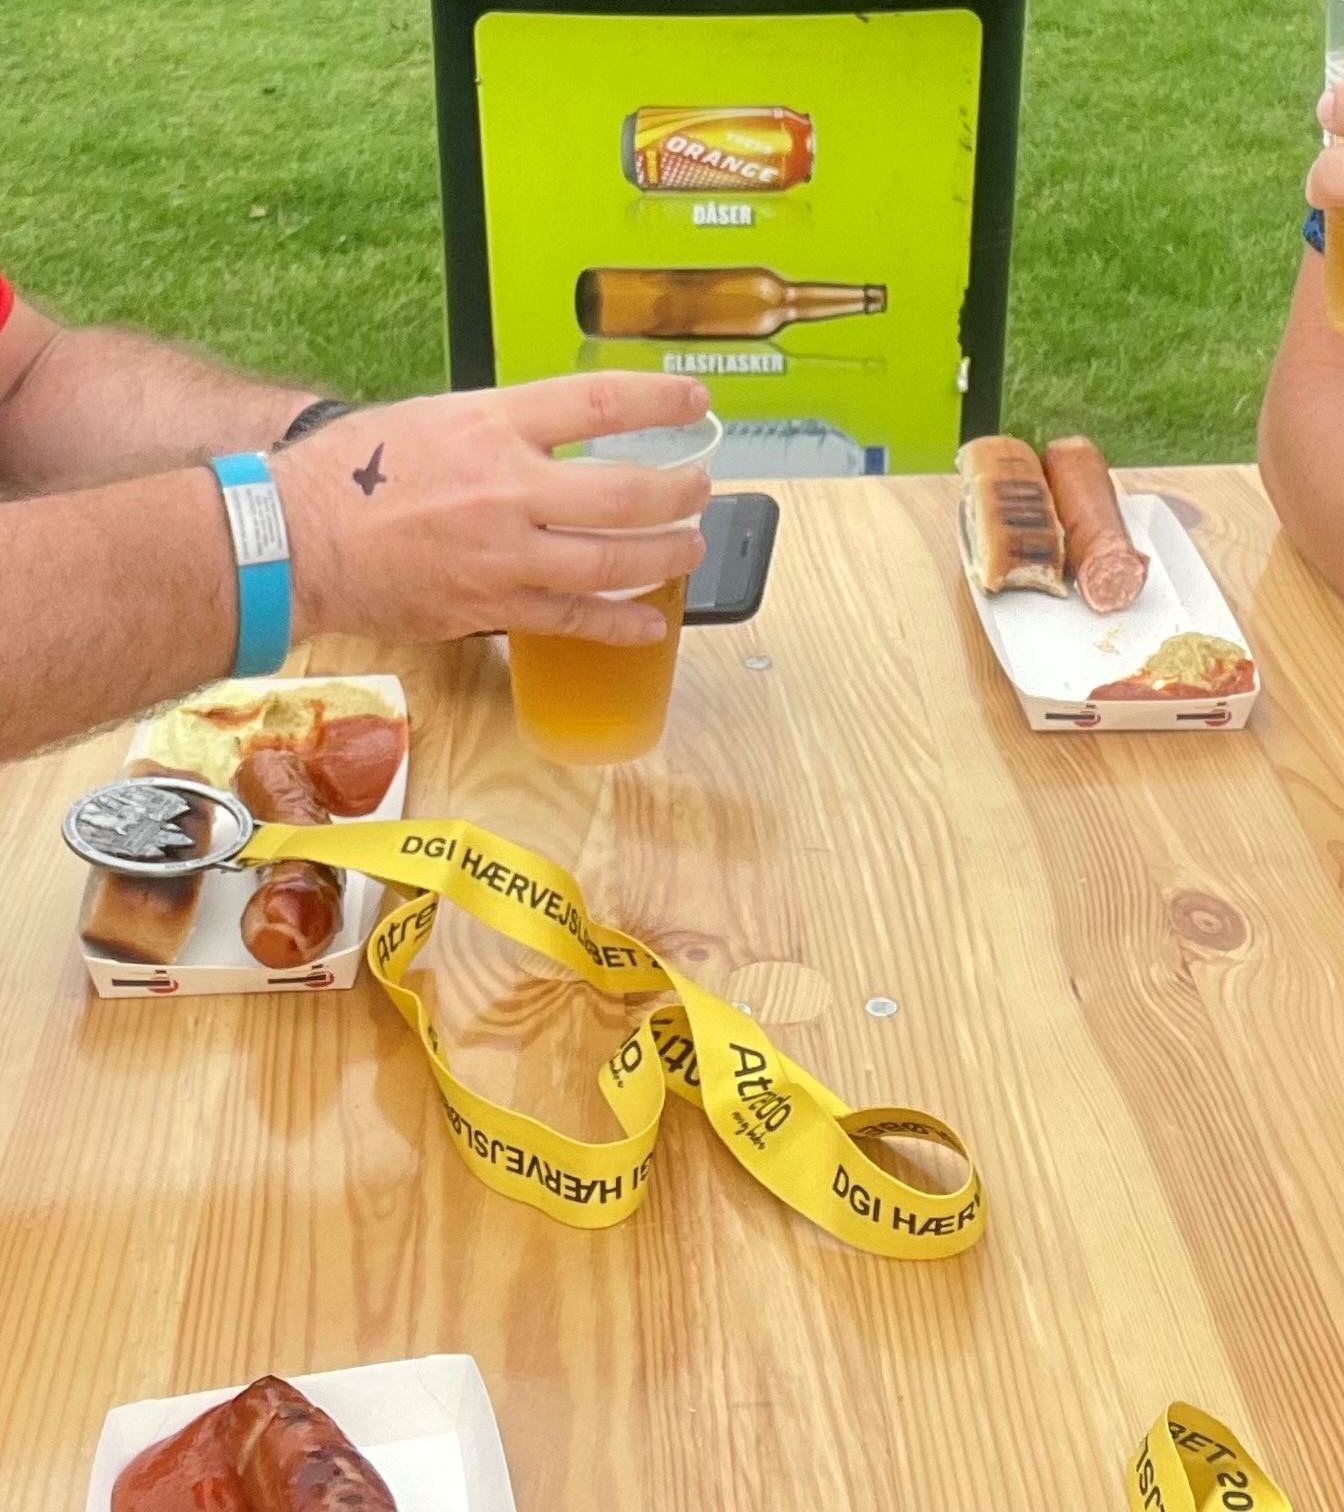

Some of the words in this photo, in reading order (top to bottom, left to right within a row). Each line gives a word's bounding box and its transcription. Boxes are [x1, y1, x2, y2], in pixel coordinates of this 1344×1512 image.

[666, 133, 779, 183] ORANGE
[693, 202, 752, 225] DÅSER
[663, 352, 786, 374] GLASFLASKER
[401, 835, 457, 862] DGI
[832, 1164, 881, 1223] DGI
